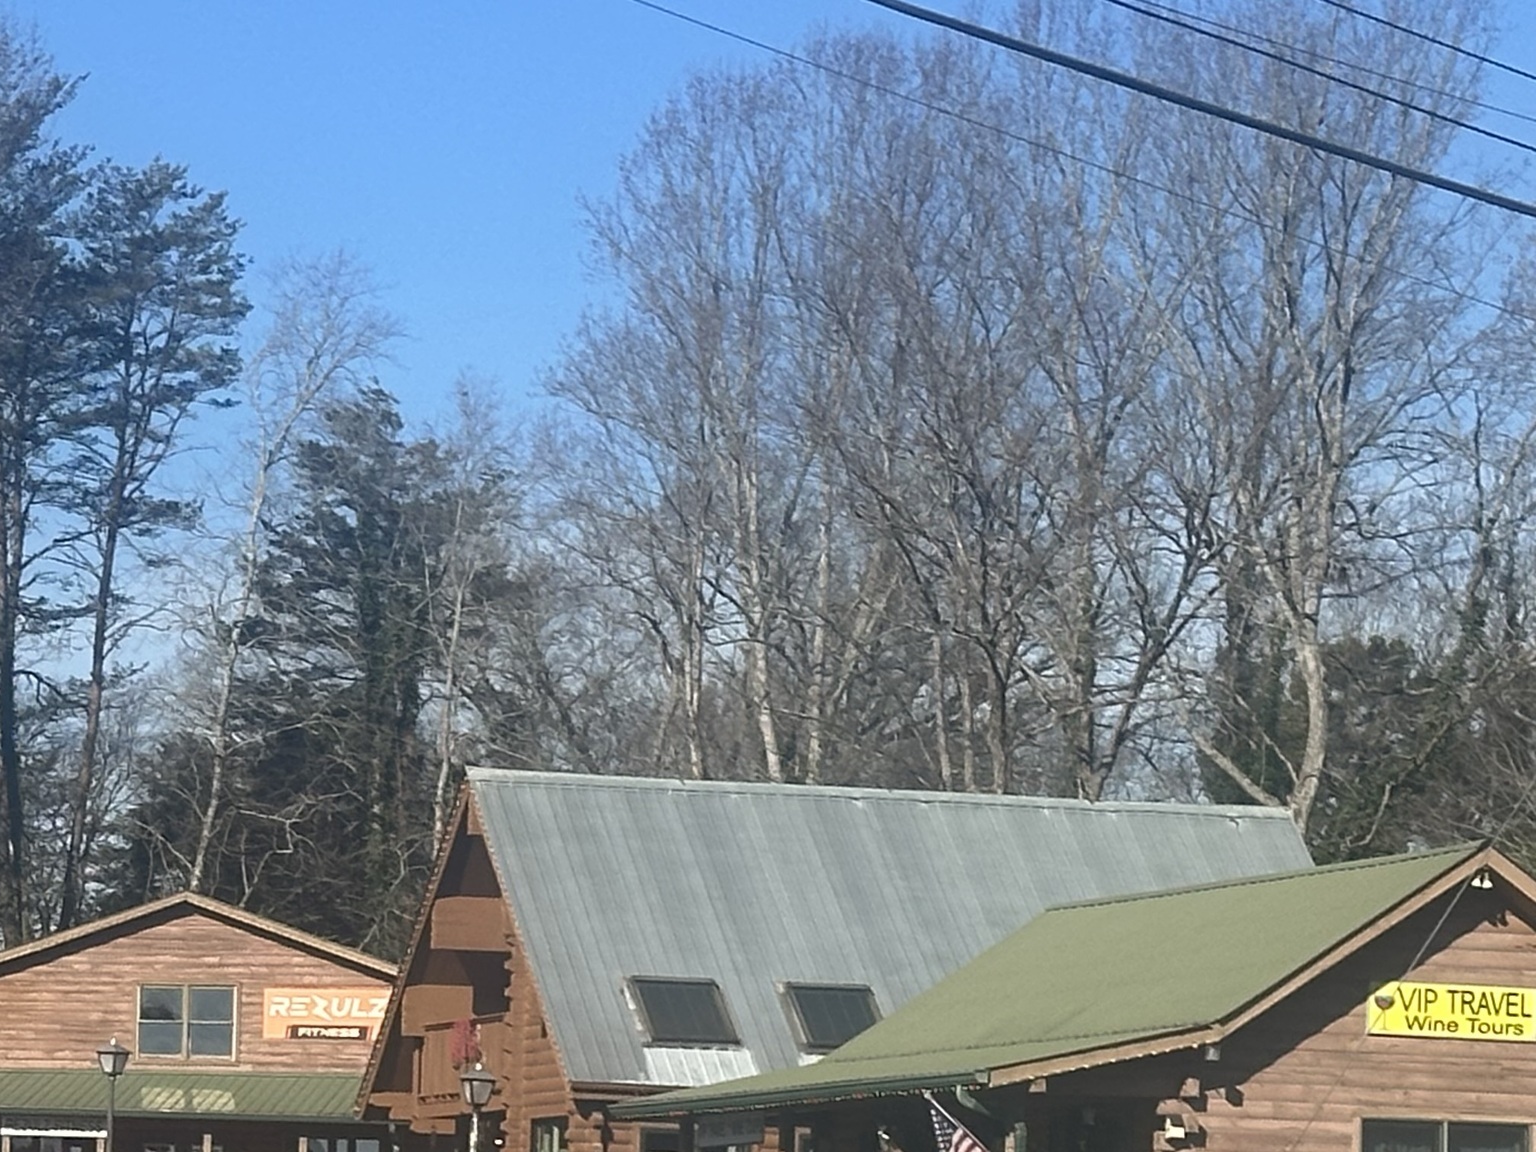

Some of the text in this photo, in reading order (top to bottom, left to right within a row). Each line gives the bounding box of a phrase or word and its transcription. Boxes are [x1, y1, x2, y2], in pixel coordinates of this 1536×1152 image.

[1396, 986, 1533, 1018] VIP TRAVEL
[297, 1026, 361, 1038] FITNESS
[1404, 1014, 1525, 1036] Wine Tours
